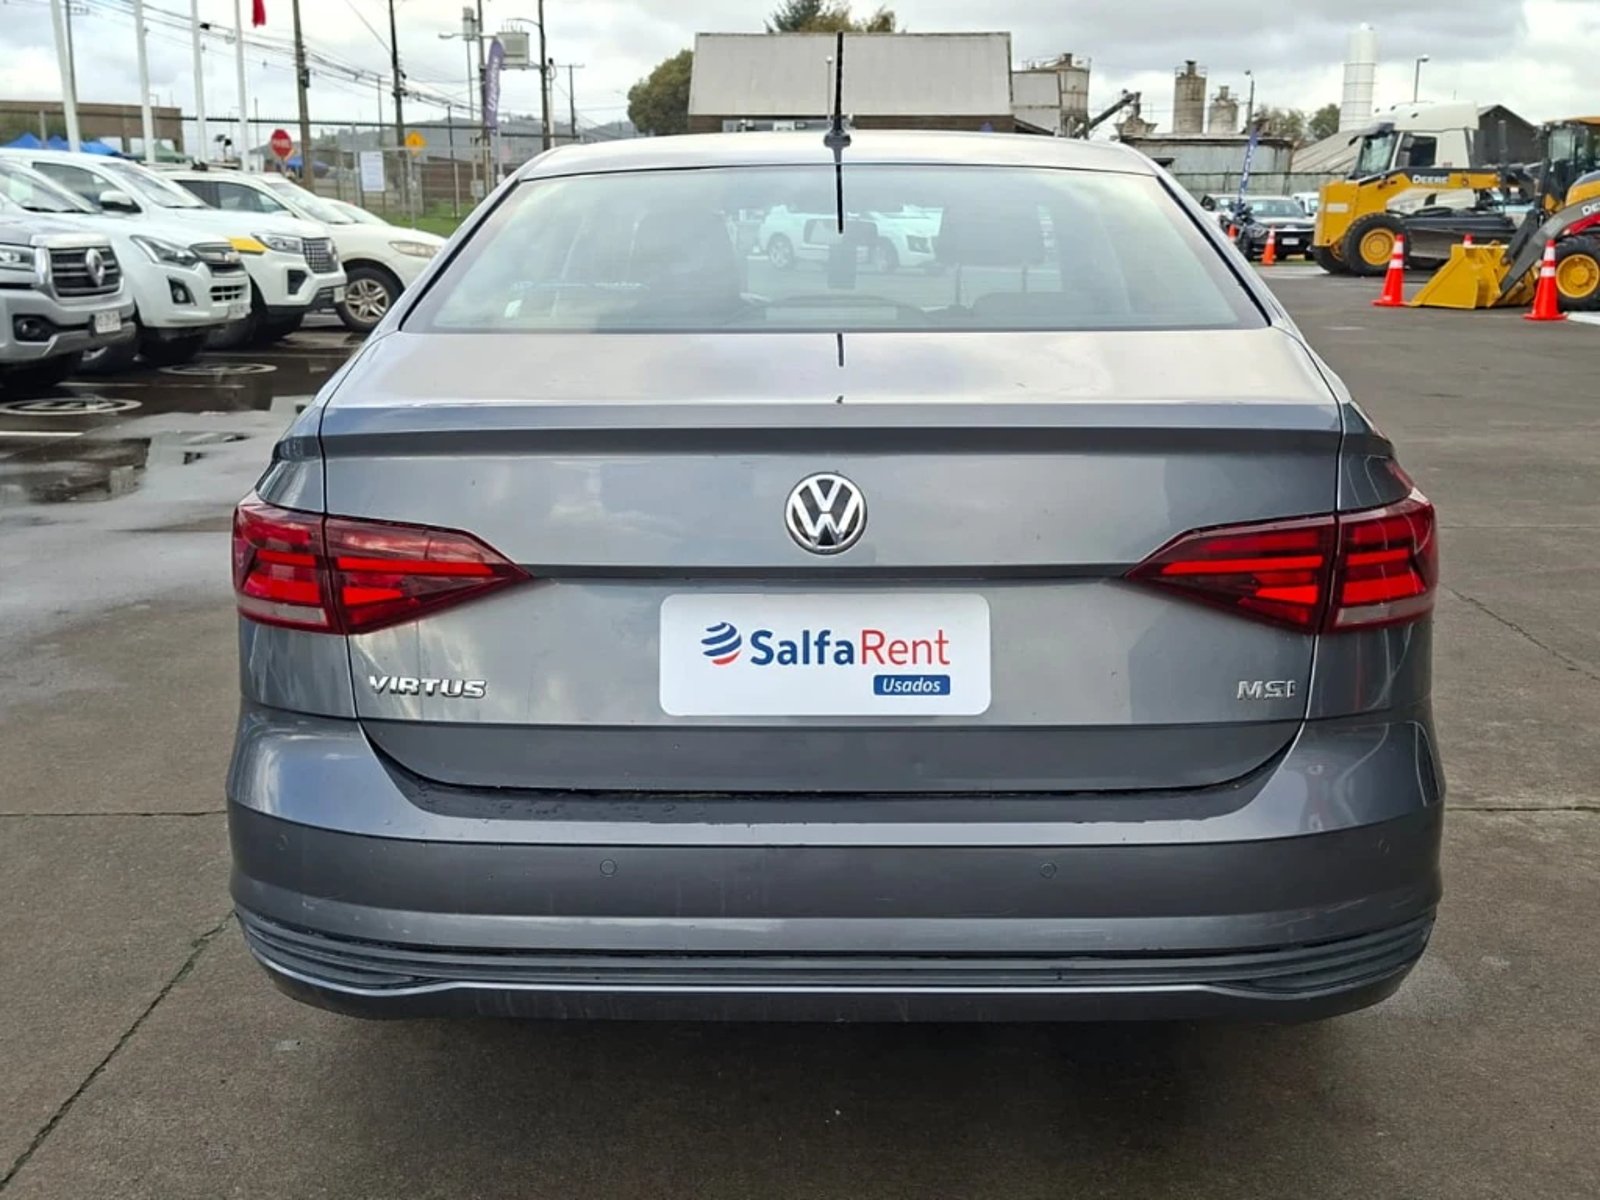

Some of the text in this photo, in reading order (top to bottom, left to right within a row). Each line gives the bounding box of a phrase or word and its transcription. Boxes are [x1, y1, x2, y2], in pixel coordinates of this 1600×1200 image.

[368, 675, 487, 699] VIRTUS
[882, 677, 941, 693] Usados
[1237, 679, 1296, 700] MSI
